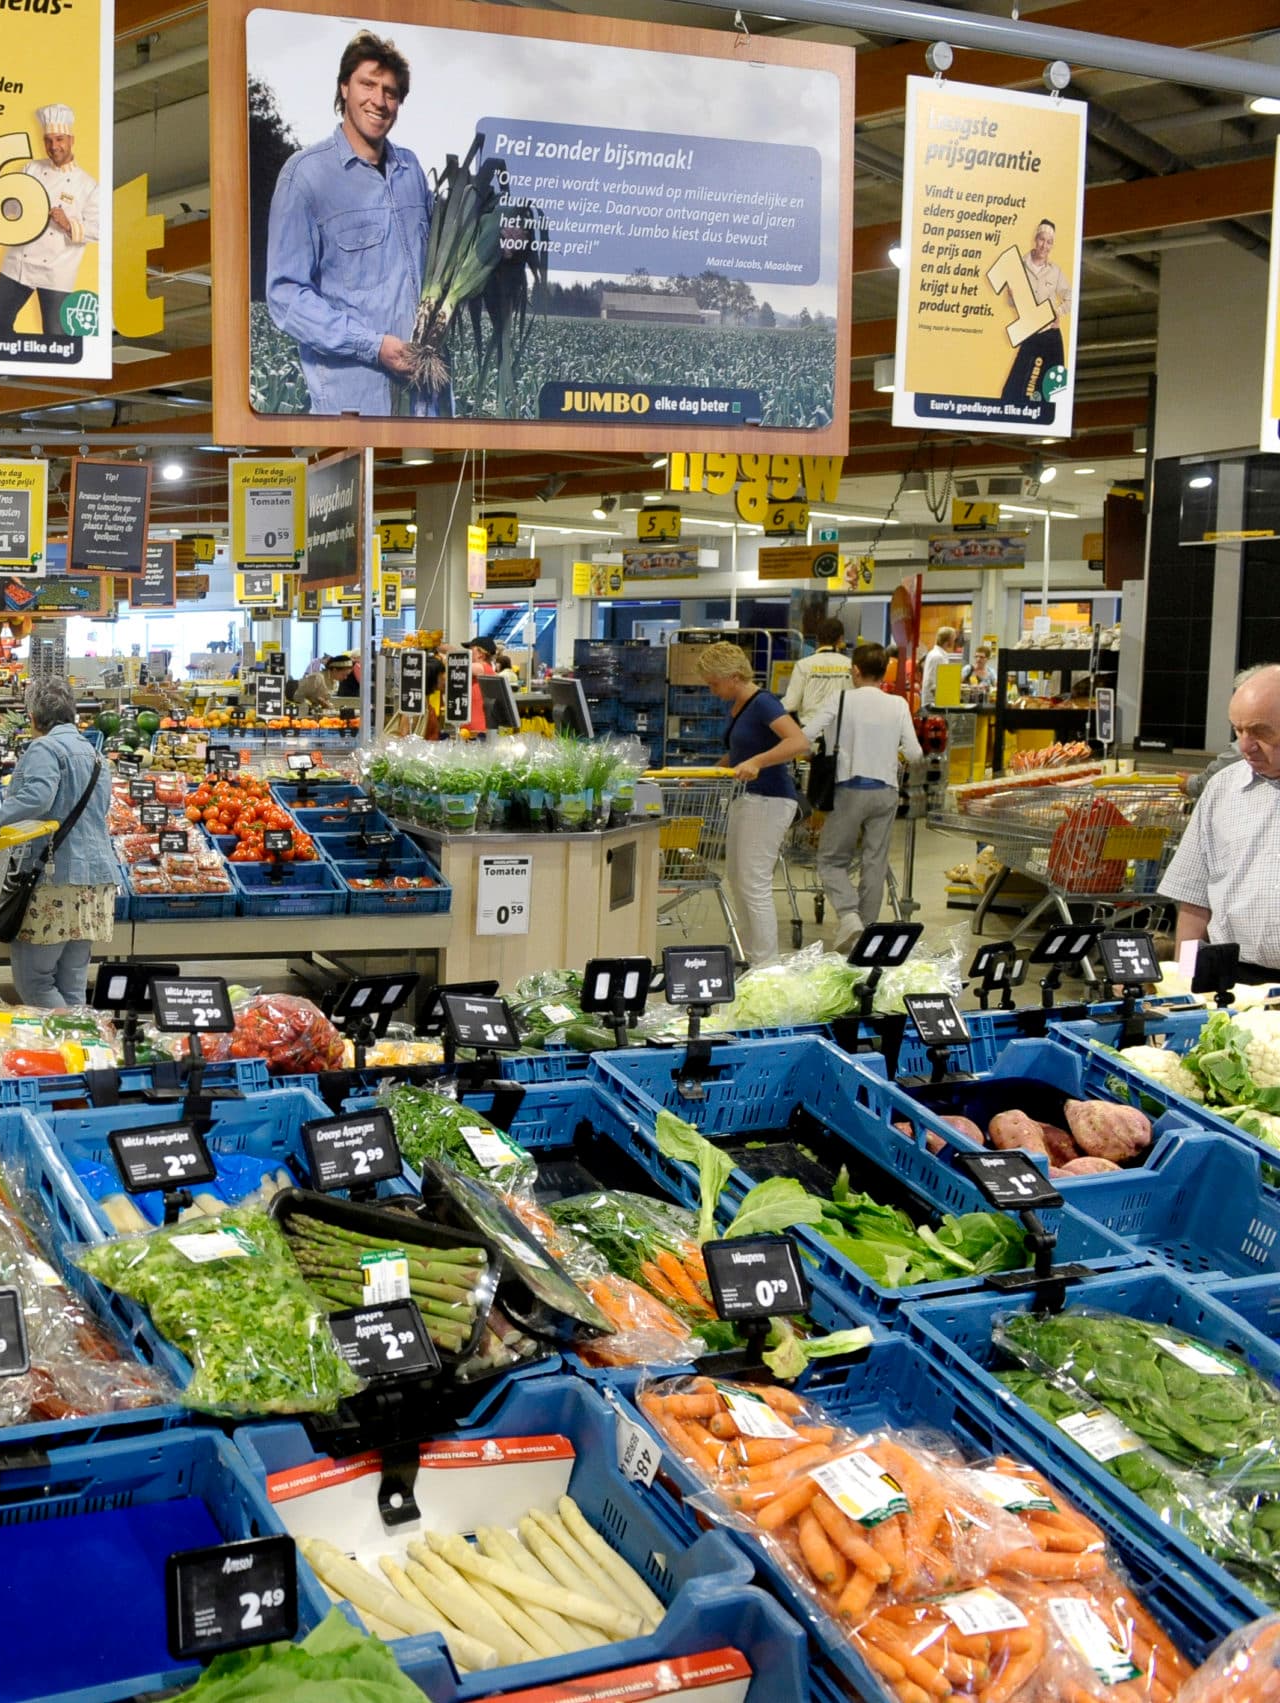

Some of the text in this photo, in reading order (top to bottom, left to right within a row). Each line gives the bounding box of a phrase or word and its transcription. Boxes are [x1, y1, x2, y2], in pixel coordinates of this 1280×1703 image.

[927, 105, 999, 140] Laagste
[495, 134, 694, 170] Prei zonder bijsmaak!
[924, 140, 1041, 173] prijsgarantie
[534, 176, 560, 192] prei
[562, 177, 599, 191] wordt
[603, 180, 663, 196] verbouwd
[666, 186, 682, 201] op
[684, 186, 789, 209] milieuvriendelijke
[790, 197, 804, 208] en
[924, 184, 1026, 209] Vindt u een product
[499, 194, 795, 229] duurzame wijze. Daarvoor ontvangen we al jaren
[923, 204, 1018, 226] elders goedkoper?
[499, 214, 769, 247] het milieukeurmerk. Jumbo kiest dus bewust
[923, 223, 1001, 245] Dan passen wij
[499, 238, 560, 253] voor onze
[921, 242, 982, 260] de prijs aan
[706, 257, 803, 273] Marcel Jacobs, Maasbree
[921, 261, 980, 279] en als dank
[920, 279, 978, 297] krijgt u het
[919, 300, 994, 318] product gratis.
[23, 339, 47, 352] Elke
[48, 341, 75, 357] dag!
[560, 390, 729, 415] JUMBO elke dag beter
[956, 402, 1003, 416] goedkoper.
[1004, 404, 1021, 416] Elke
[1022, 406, 1041, 419] dag!
[251, 498, 290, 506] Tomaten
[309, 478, 354, 522] Weegschaal
[773, 508, 784, 526] 6
[963, 502, 975, 518] 7
[648, 516, 657, 532] 5
[485, 867, 527, 876] Tomaten
